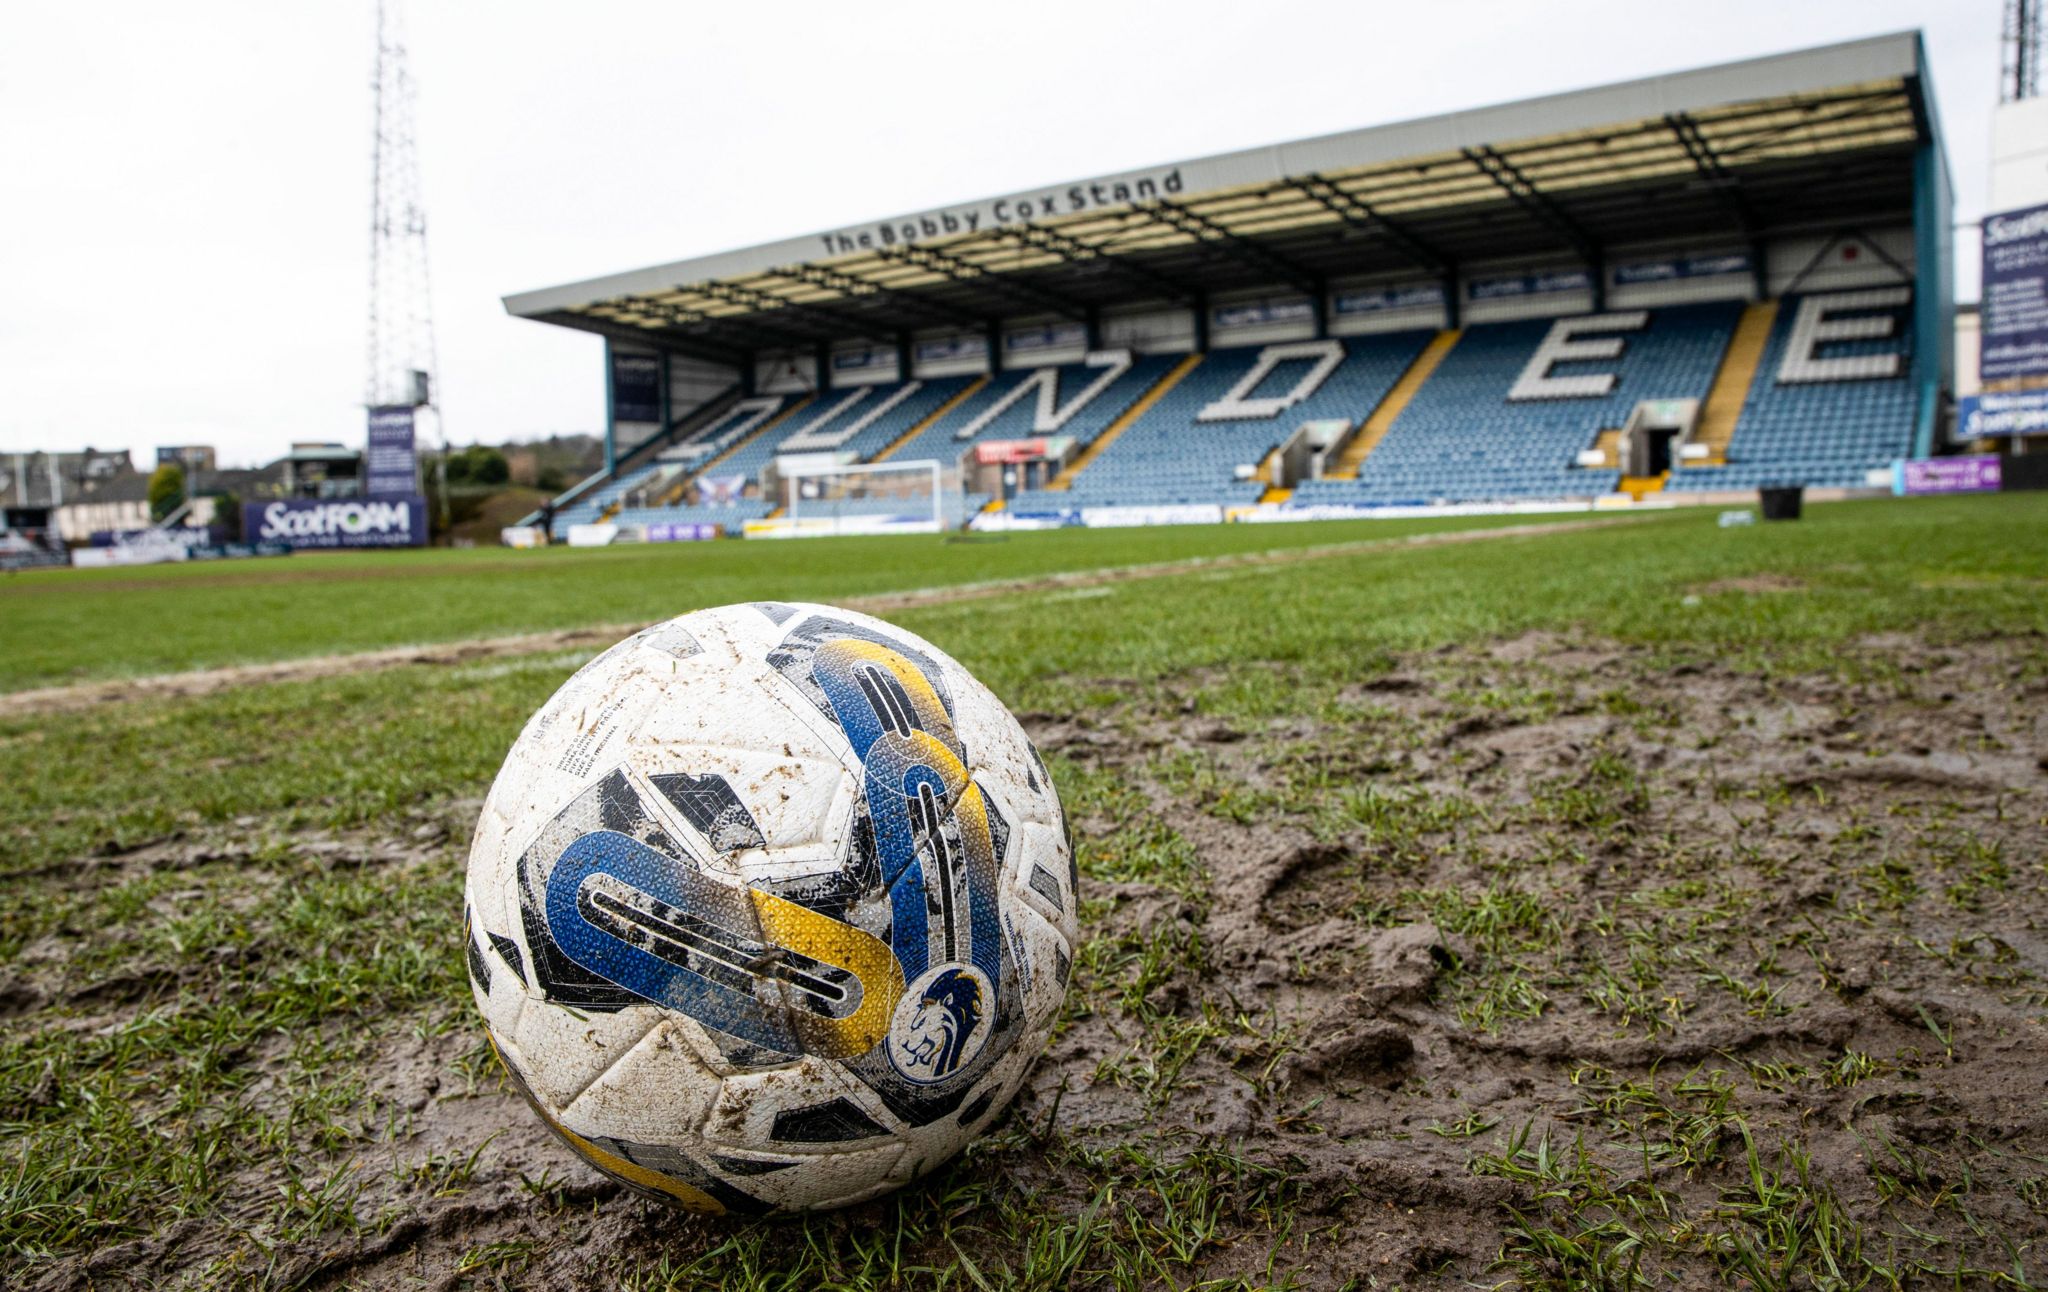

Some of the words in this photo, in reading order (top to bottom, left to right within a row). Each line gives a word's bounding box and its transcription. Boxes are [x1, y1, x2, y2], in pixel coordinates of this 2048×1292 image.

[821, 232, 873, 256] The
[878, 209, 980, 246] Bobby
[992, 194, 1057, 224] Cox
[1066, 167, 1184, 212] Stand
[562, 750, 578, 772] PUMA
[568, 758, 580, 774] FIFA
[579, 727, 601, 756] QUALITY
[574, 760, 587, 776] SIZE
[581, 756, 596, 779] MADE
[599, 725, 618, 749] CHINA
